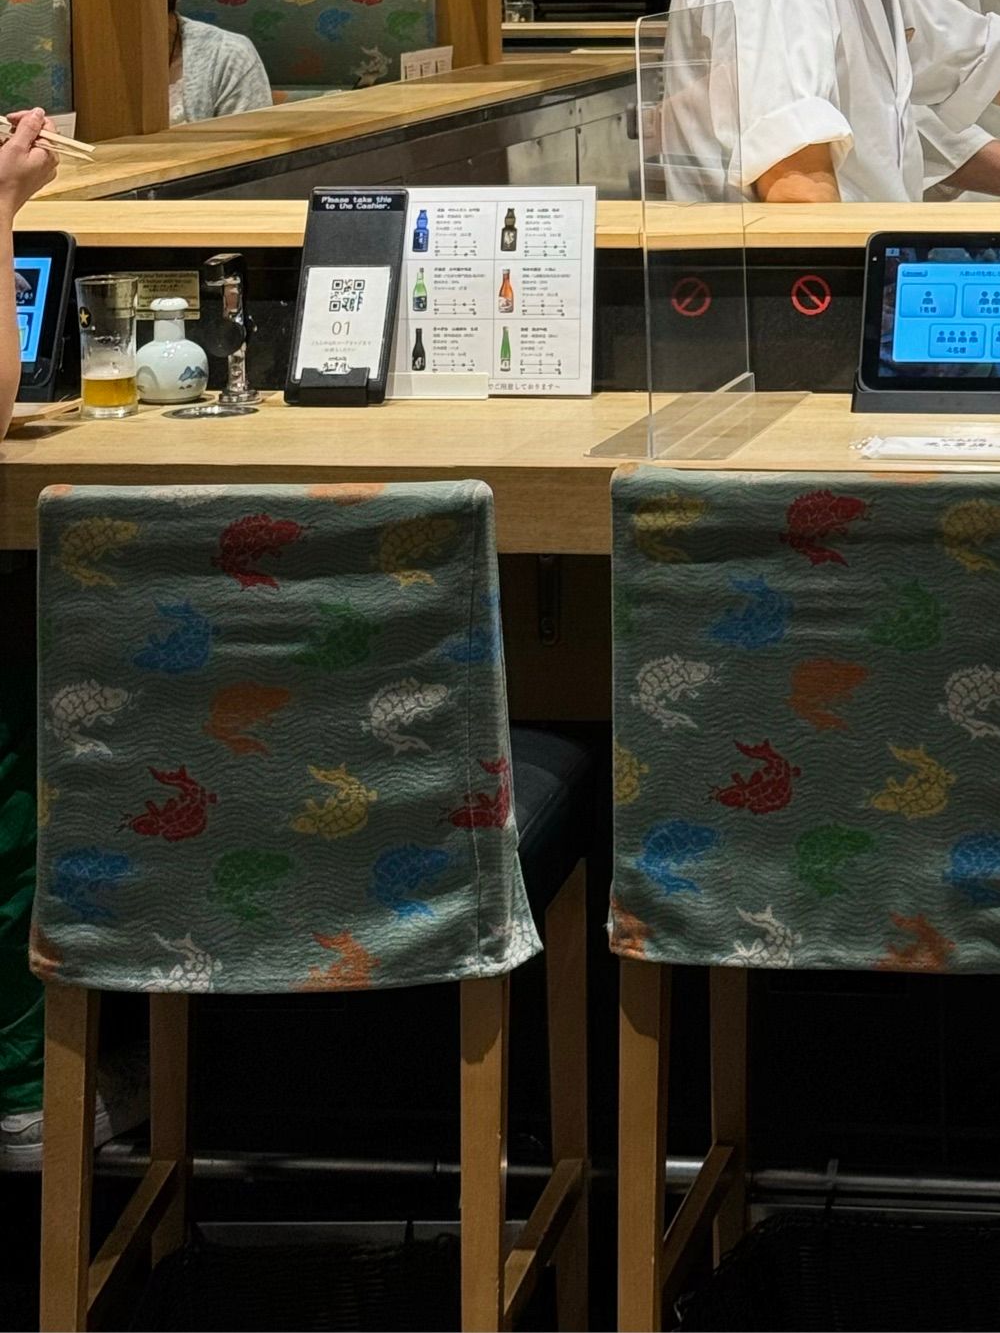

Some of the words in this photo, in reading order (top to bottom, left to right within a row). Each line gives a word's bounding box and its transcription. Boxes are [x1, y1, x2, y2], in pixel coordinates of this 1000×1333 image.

[321, 196, 350, 204] Please
[353, 196, 373, 204] take
[375, 195, 393, 204] this
[331, 321, 351, 336] 01
